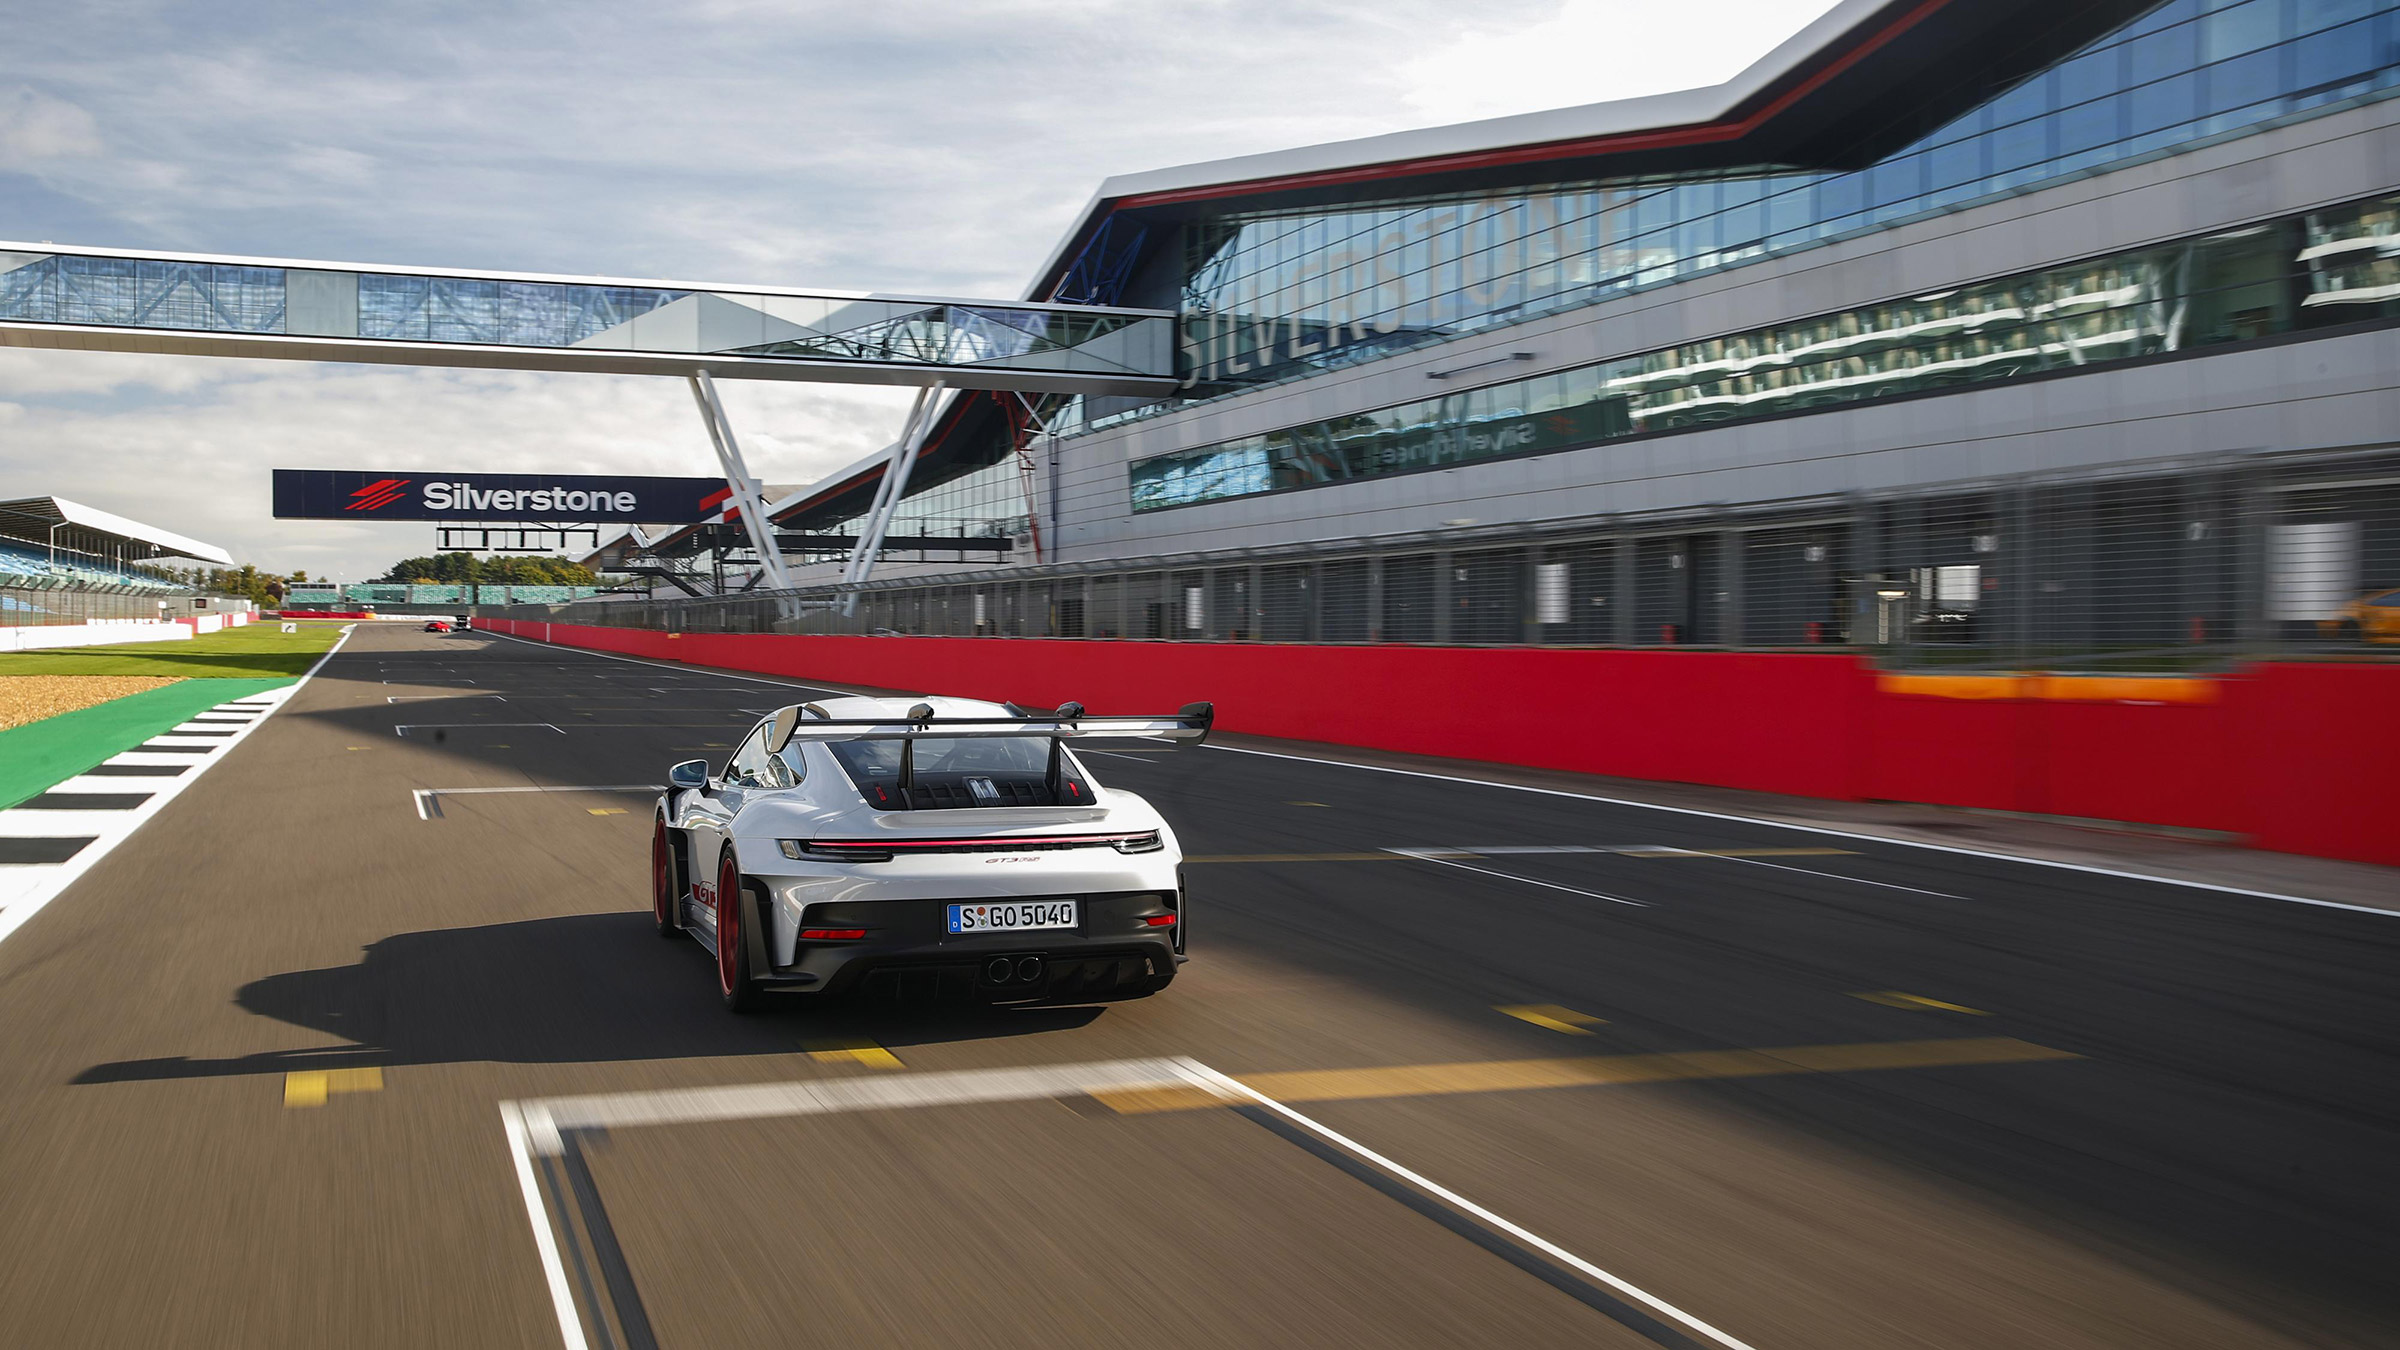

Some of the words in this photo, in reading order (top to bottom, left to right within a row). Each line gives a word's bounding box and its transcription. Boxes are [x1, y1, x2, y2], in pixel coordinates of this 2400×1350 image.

[1180, 186, 1638, 390] SILVERSTONE
[422, 481, 637, 512] Silverstone
[962, 908, 975, 928] S
[990, 906, 1017, 927] GO
[1021, 904, 1072, 926] 5040
